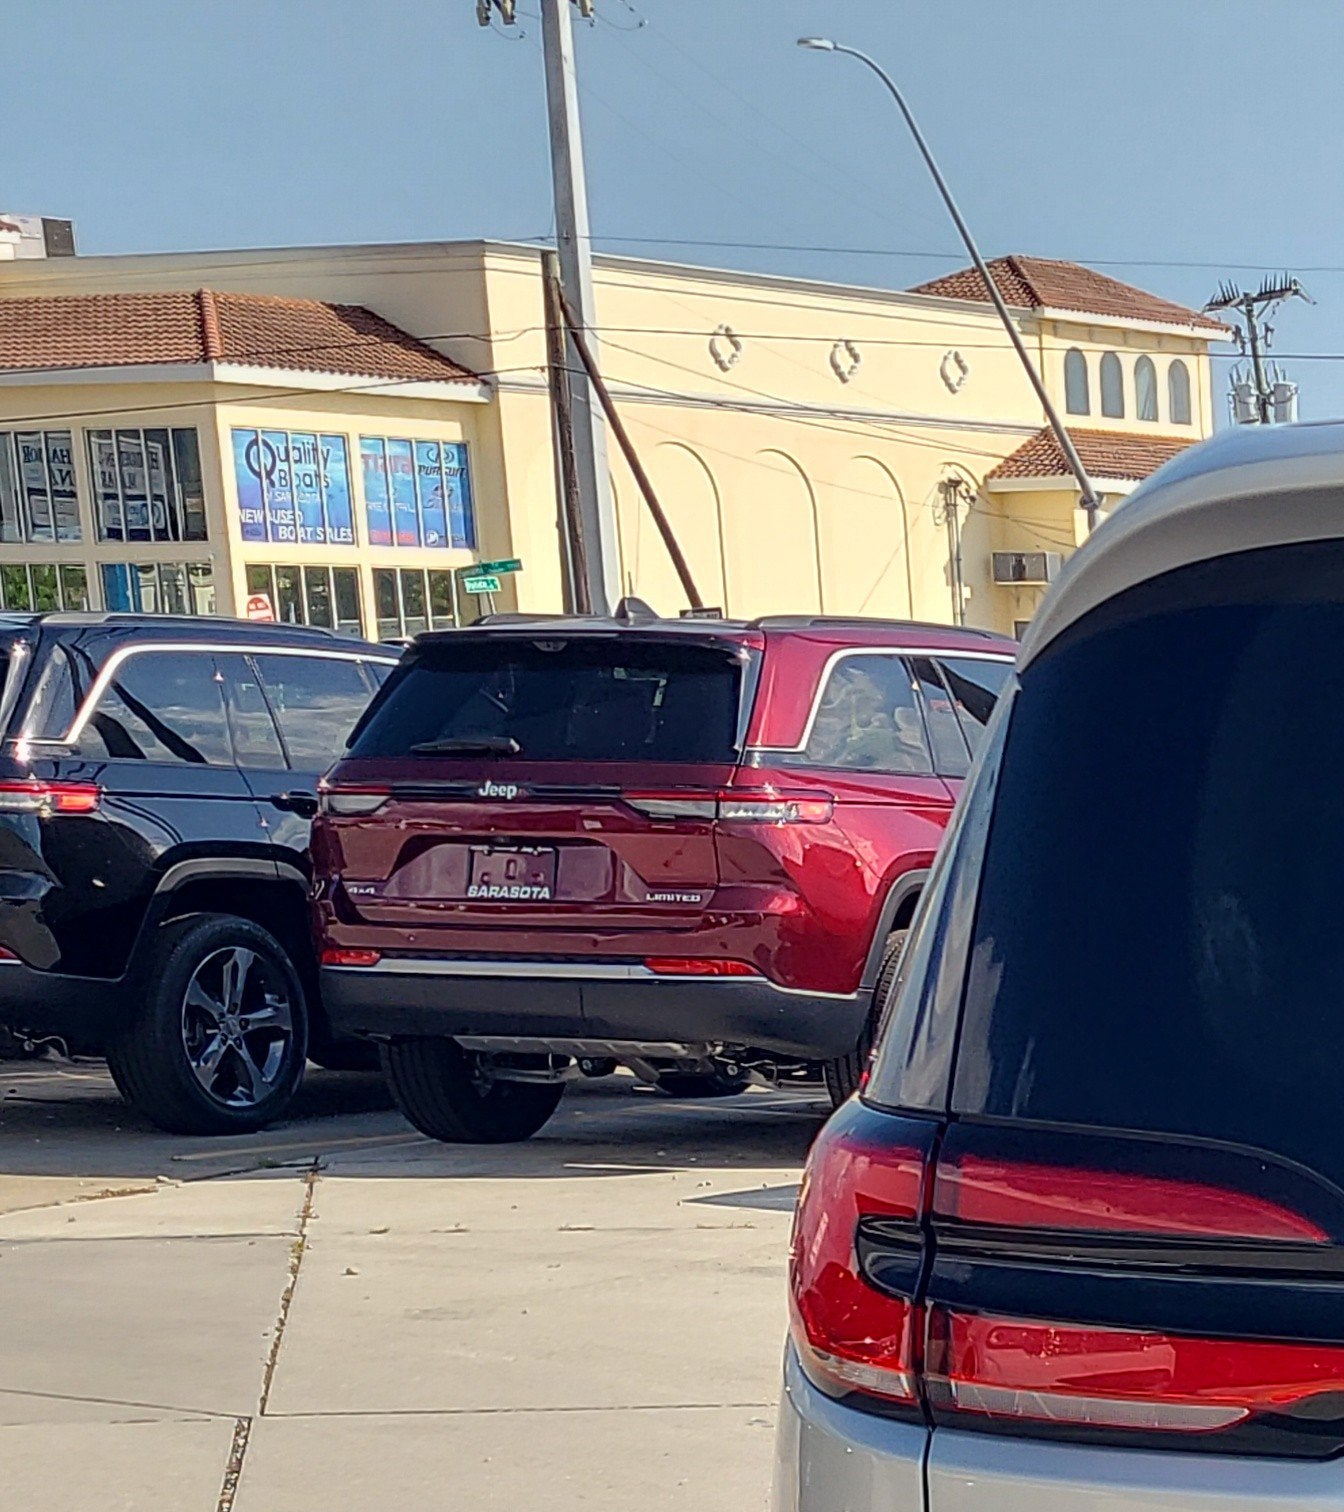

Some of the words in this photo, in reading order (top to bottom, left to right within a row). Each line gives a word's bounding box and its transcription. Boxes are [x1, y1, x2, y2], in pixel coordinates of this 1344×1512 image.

[240, 508, 263, 523] NEW
[479, 780, 517, 799] Jeep
[467, 885, 551, 899] SARASOTA
[645, 893, 701, 902] LIMITED
